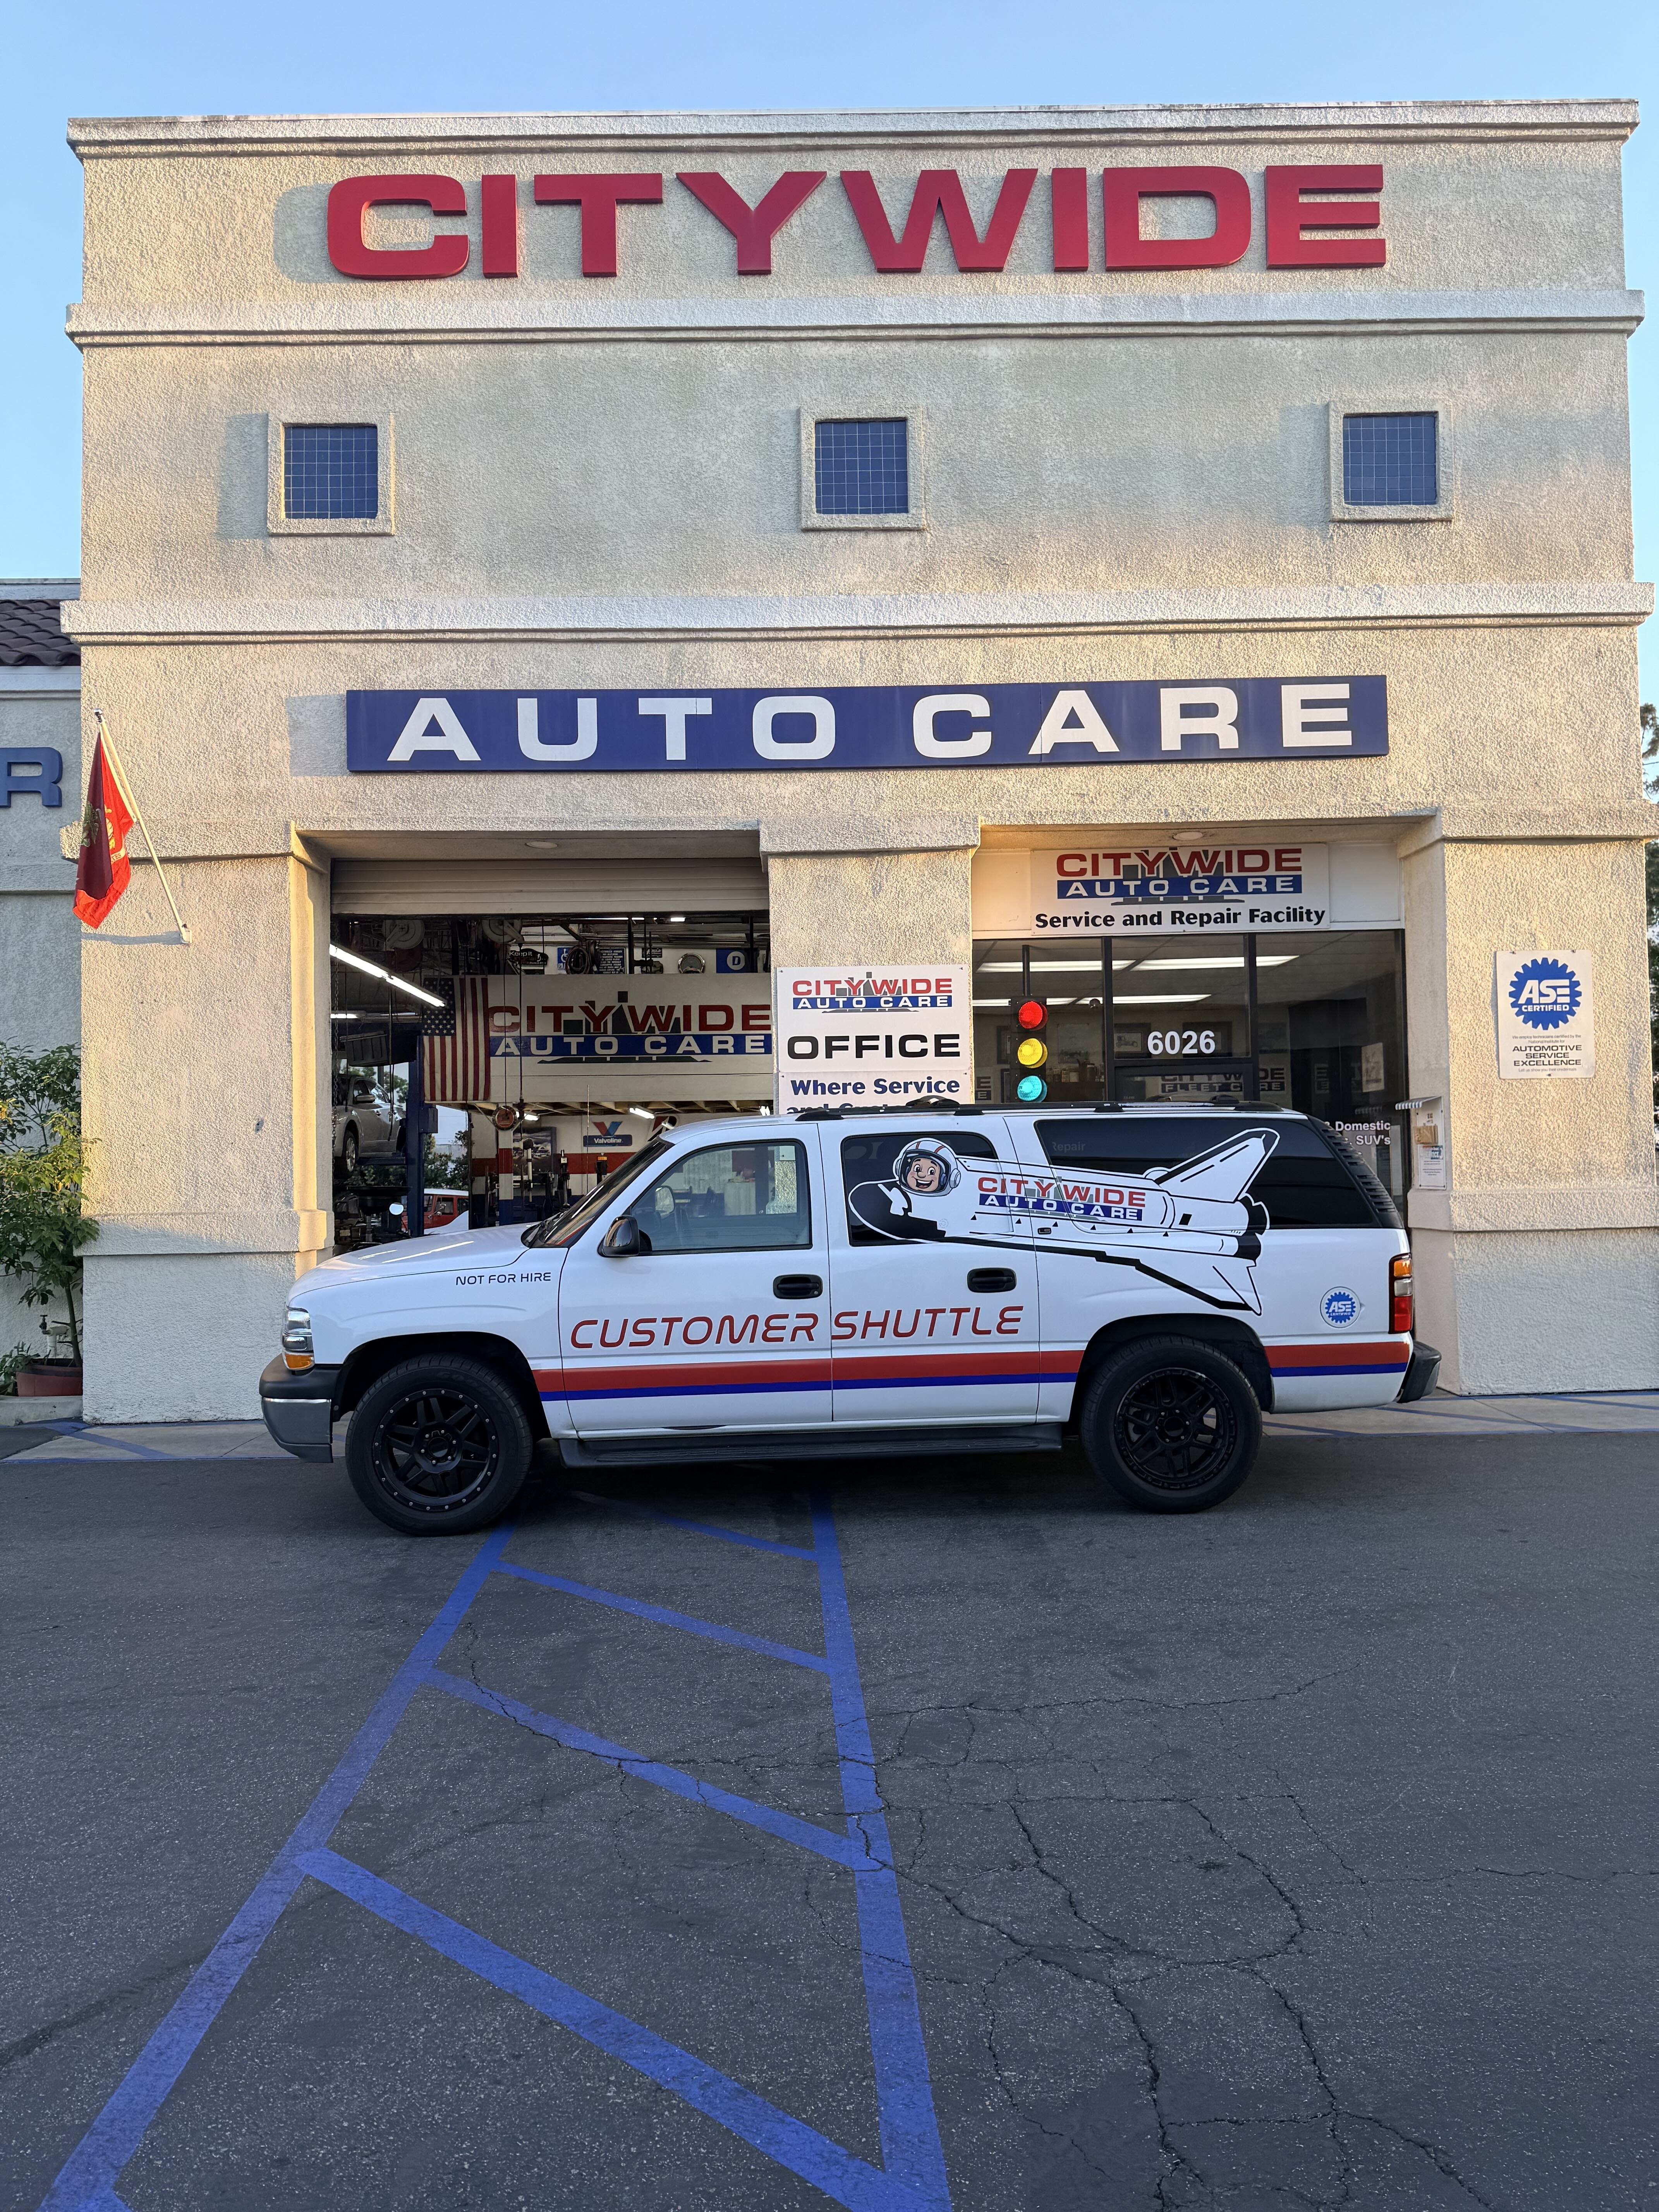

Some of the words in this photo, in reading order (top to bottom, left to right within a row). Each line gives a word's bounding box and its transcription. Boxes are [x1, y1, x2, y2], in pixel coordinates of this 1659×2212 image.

[328, 165, 1386, 278] CITYWIDE
[387, 696, 835, 761] AUTO
[913, 683, 1353, 758] CARE
[1066, 880, 1169, 897] AUTO
[1190, 877, 1294, 894] CARE
[1036, 910, 1115, 928] Service
[1123, 911, 1162, 926] and
[1171, 908, 1242, 927] Repair
[1249, 906, 1326, 926] Facility
[1518, 979, 1570, 1004] ASE
[797, 997, 866, 1009] AUTO
[880, 996, 948, 1007] CARE
[495, 1036, 618, 1055] AUTO
[644, 1035, 764, 1054] CARE
[788, 1034, 960, 1059] OFFICE
[1147, 1030, 1215, 1054] 6026
[791, 1079, 866, 1095] Where
[874, 1076, 960, 1094] Service
[1165, 1084, 1222, 1092] FLEET
[1336, 1120, 1391, 1131] Domestic
[1356, 1135, 1391, 1145] SUV's
[984, 1195, 1057, 1211] AUTO
[1071, 1202, 1138, 1219] CARE
[456, 1275, 484, 1285] NOT
[489, 1274, 516, 1284] FOR
[521, 1272, 551, 1283] HIRE
[1329, 1301, 1352, 1312] ASE
[571, 1314, 818, 1348] CUSTOMER
[832, 1306, 1024, 1340] SHUTTLE
